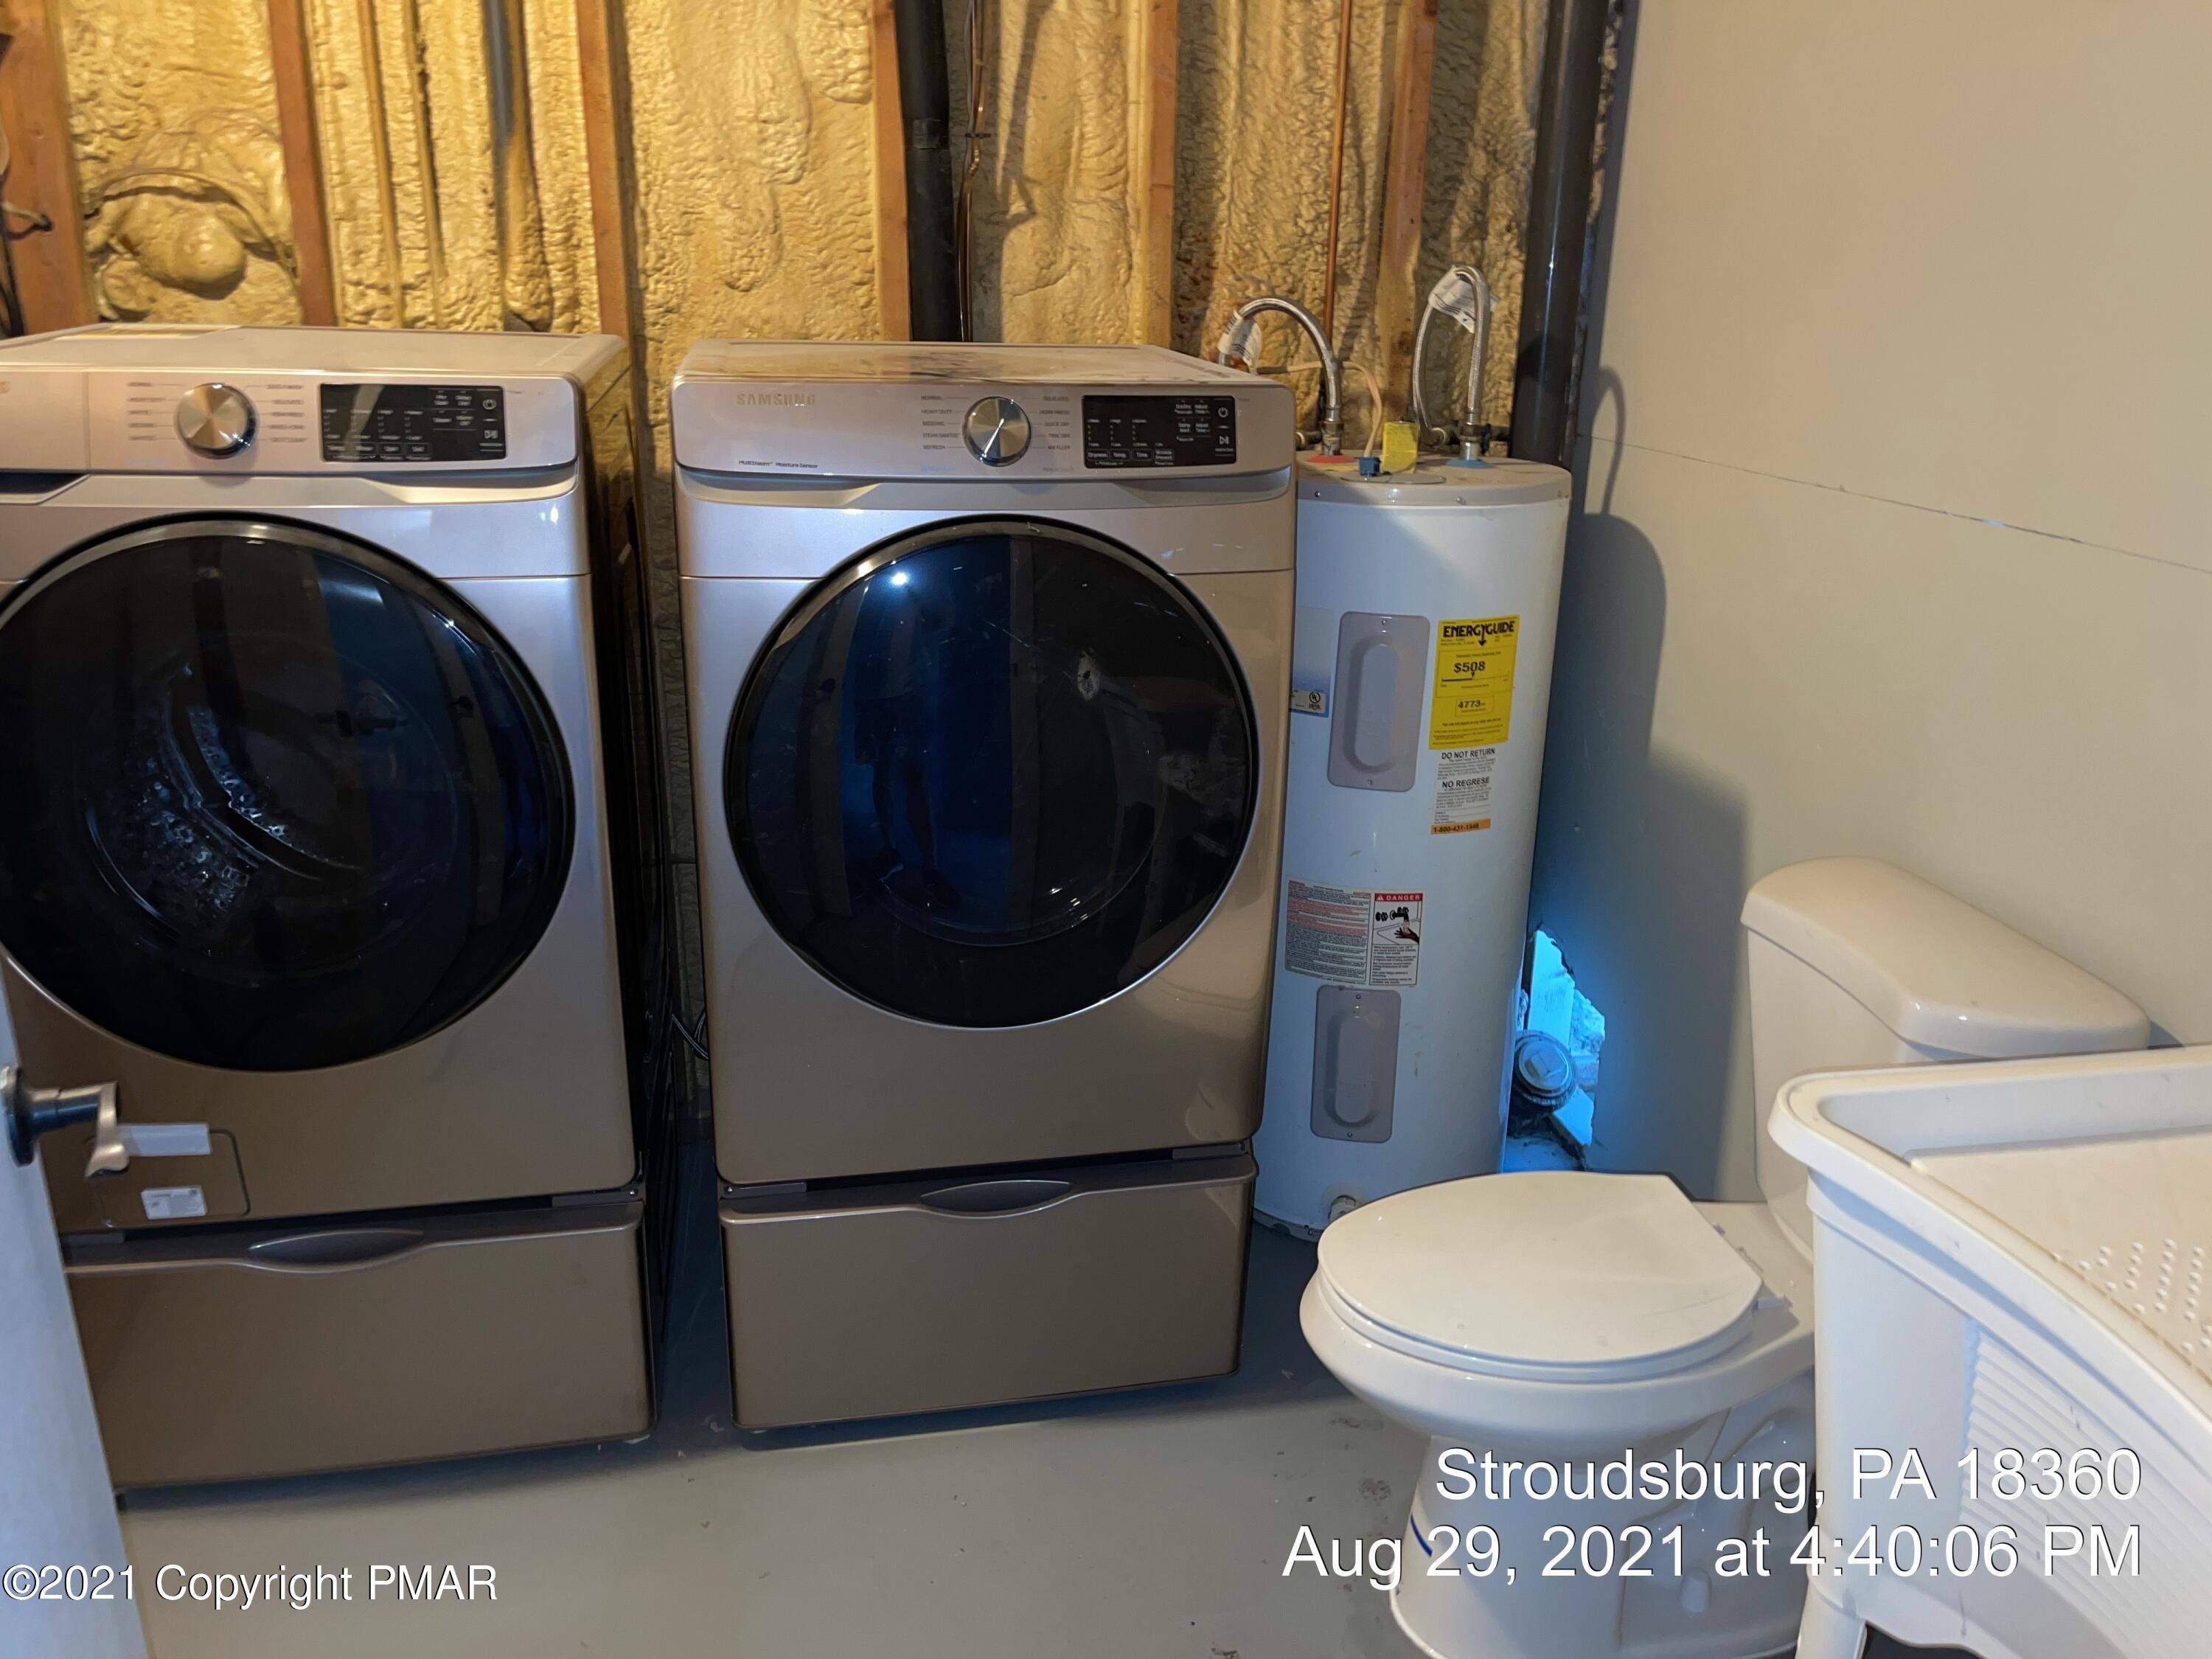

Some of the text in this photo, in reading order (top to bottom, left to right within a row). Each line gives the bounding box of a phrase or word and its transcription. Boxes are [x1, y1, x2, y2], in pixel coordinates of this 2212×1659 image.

[737, 394, 815, 406] SAMSUNG
[1453, 661, 1485, 673] $508
[1458, 700, 1481, 708] 4773
[1454, 751, 1468, 759] NOT
[1470, 748, 1495, 757] RETURN
[1456, 776, 1489, 787] REGRESE
